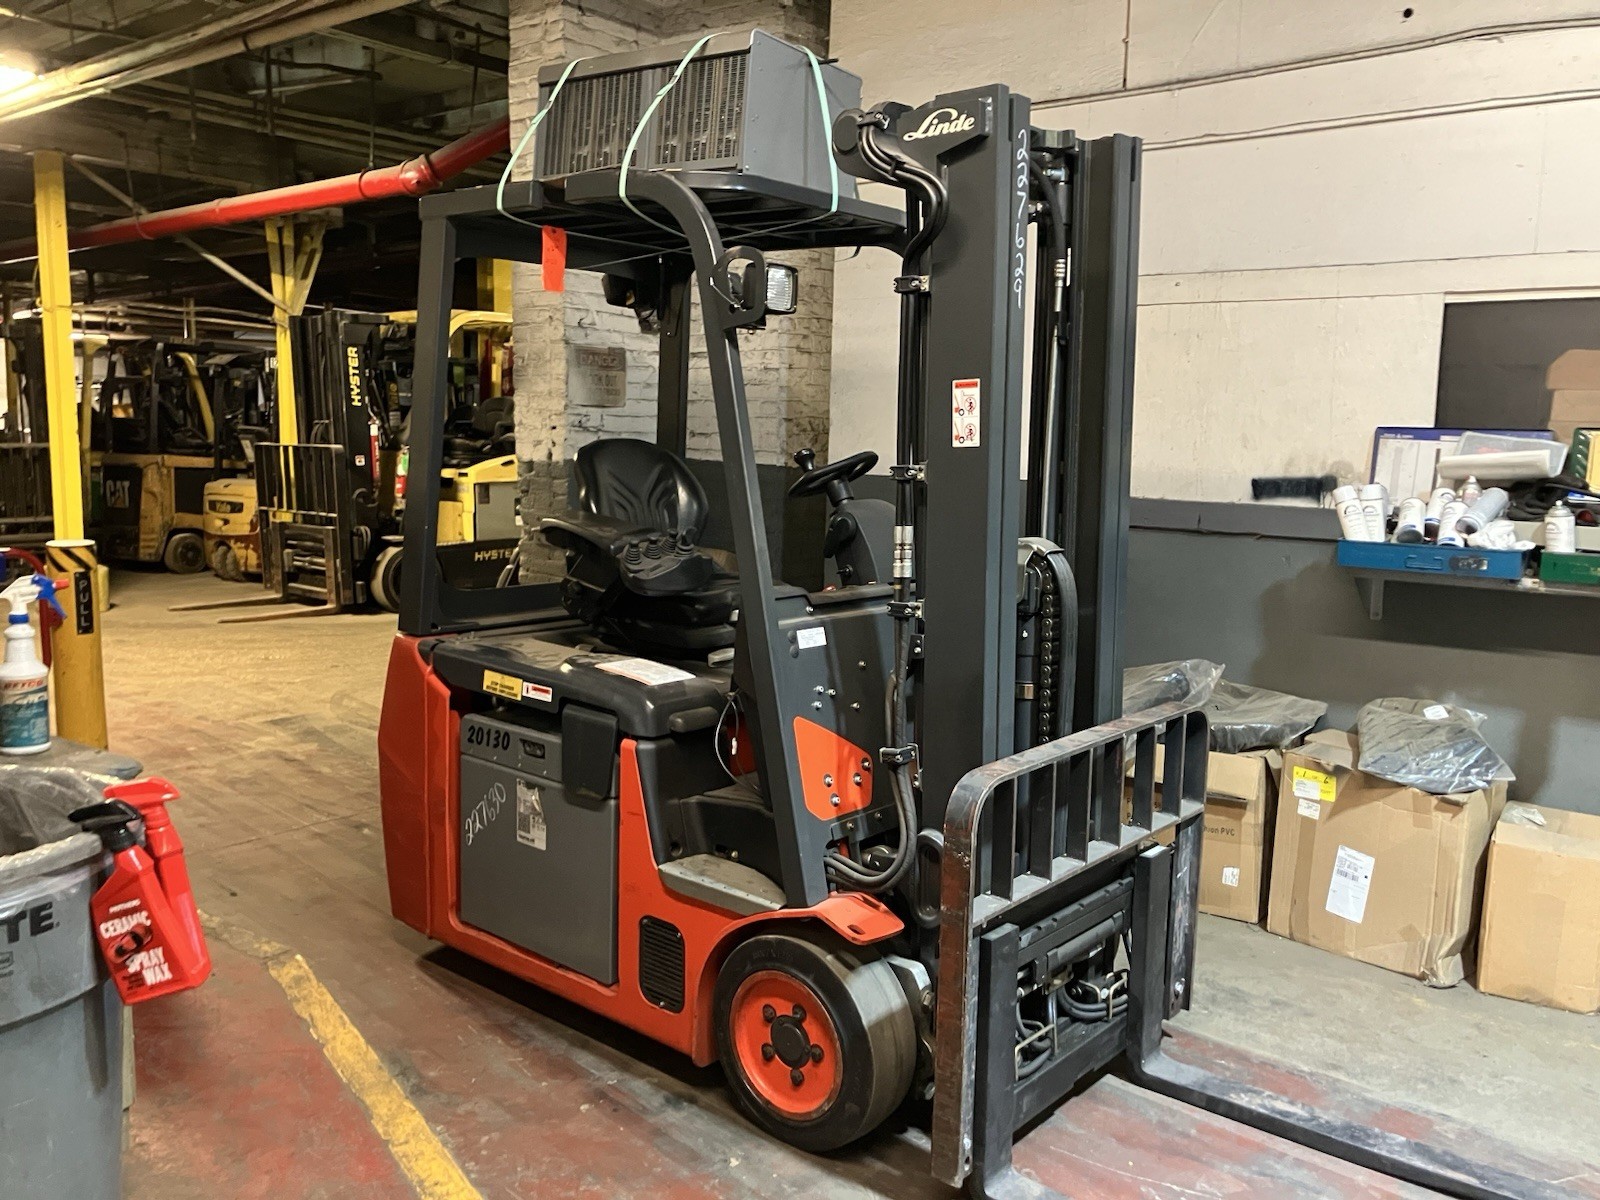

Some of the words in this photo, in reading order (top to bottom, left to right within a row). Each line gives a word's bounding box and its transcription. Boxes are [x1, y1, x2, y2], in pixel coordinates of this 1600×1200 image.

[903, 107, 975, 141] Linde
[347, 346, 362, 407] HYSTER
[106, 480, 130, 508] CAT
[474, 549, 513, 562] HYSTE
[79, 579, 90, 627] PULL
[467, 725, 511, 751] 20130
[465, 782, 506, 846] 227630
[1220, 827, 1236, 837] PVC
[100, 910, 151, 939] CERAMIC
[125, 946, 165, 974] SPRAY
[142, 962, 173, 986] WAX
